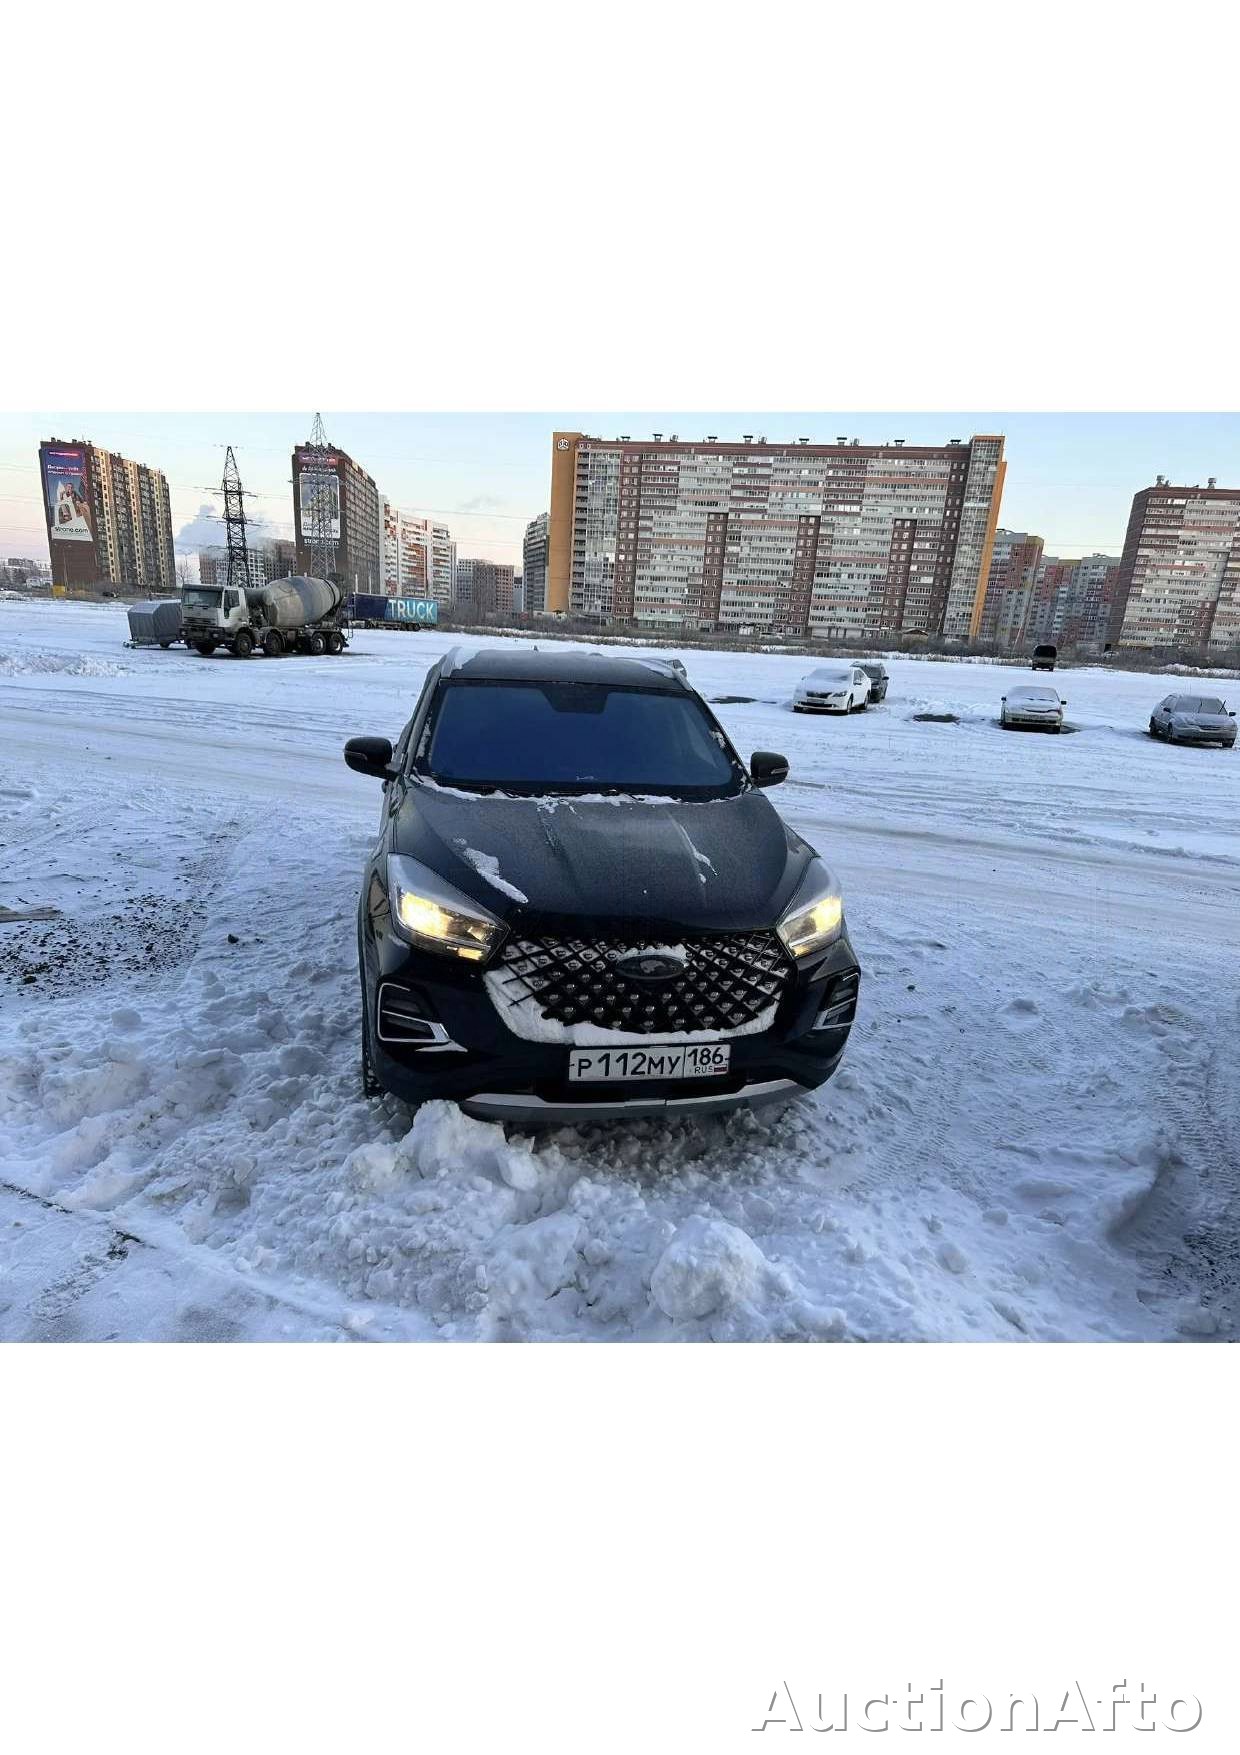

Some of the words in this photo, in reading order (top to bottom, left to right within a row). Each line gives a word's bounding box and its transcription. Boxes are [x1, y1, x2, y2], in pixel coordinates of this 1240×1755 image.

[388, 600, 434, 619] TRUCK
[688, 1047, 724, 1066] 186
[694, 1066, 713, 1074] RUS
